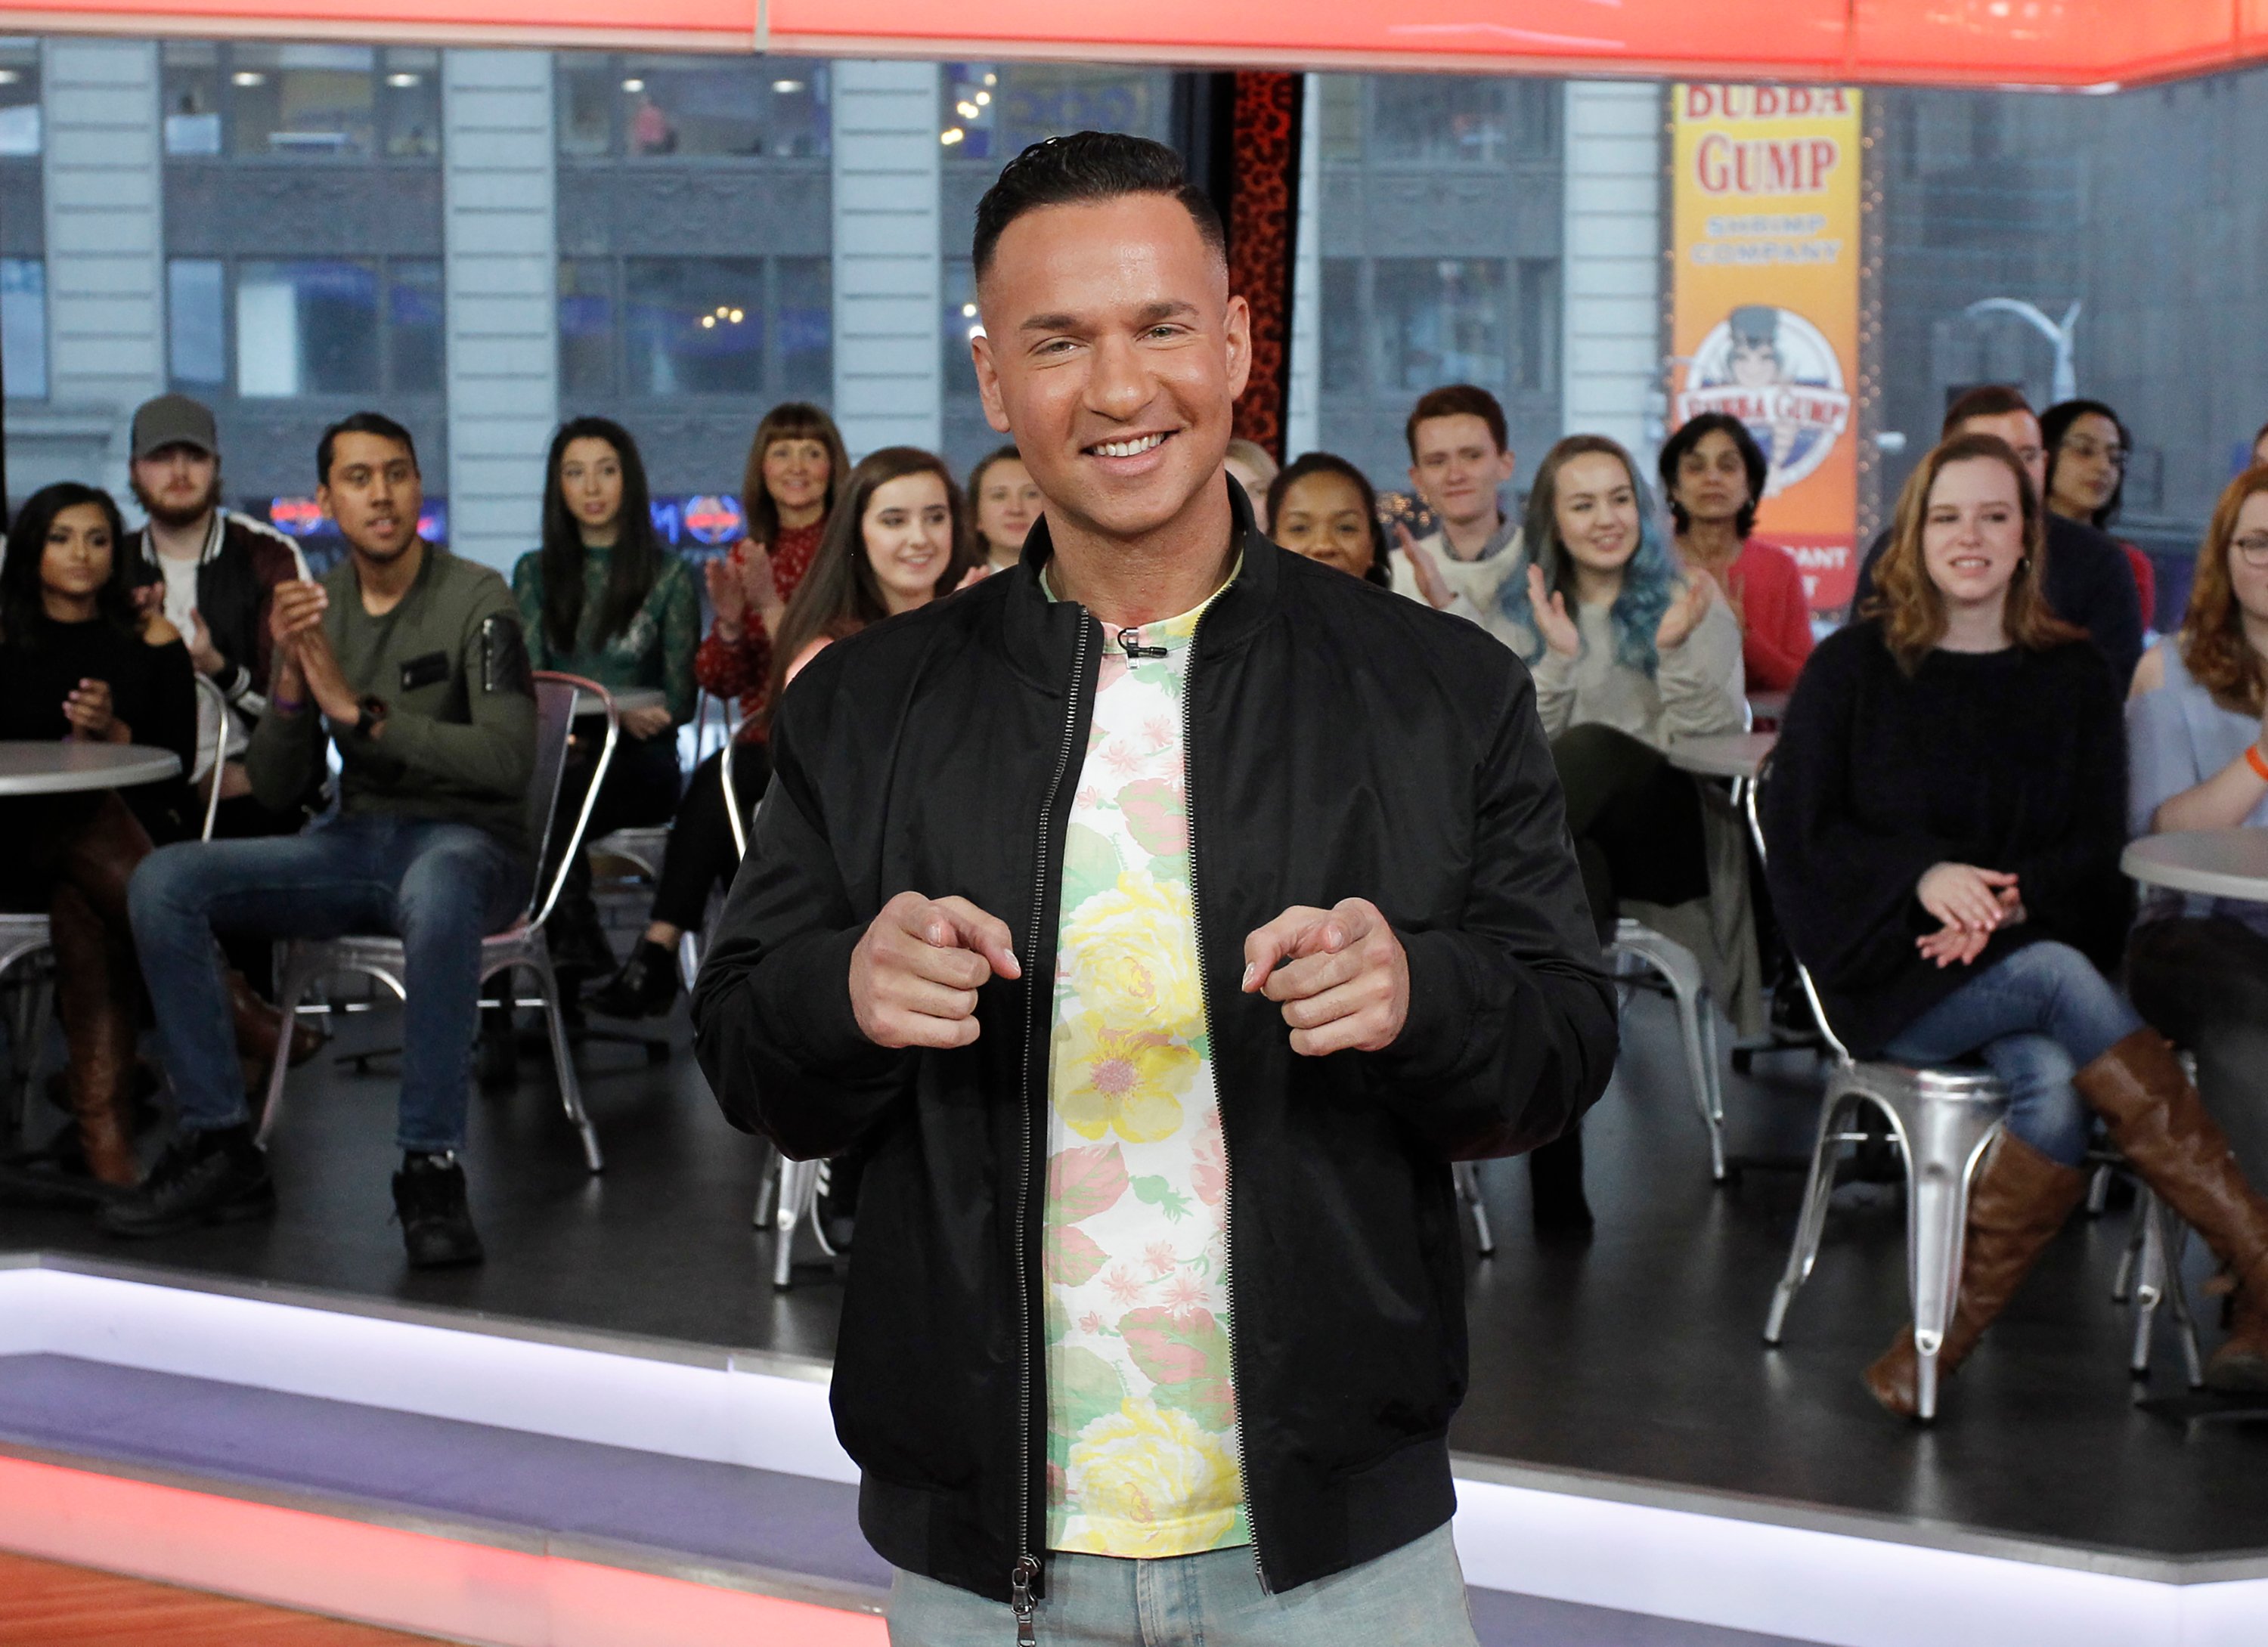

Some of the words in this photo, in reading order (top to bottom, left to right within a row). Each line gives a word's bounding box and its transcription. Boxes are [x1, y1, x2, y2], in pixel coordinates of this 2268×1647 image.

[1698, 133, 1837, 193] GUMP
[1706, 215, 1825, 237] SHRIMP
[1690, 239, 1843, 263] COMPANY
